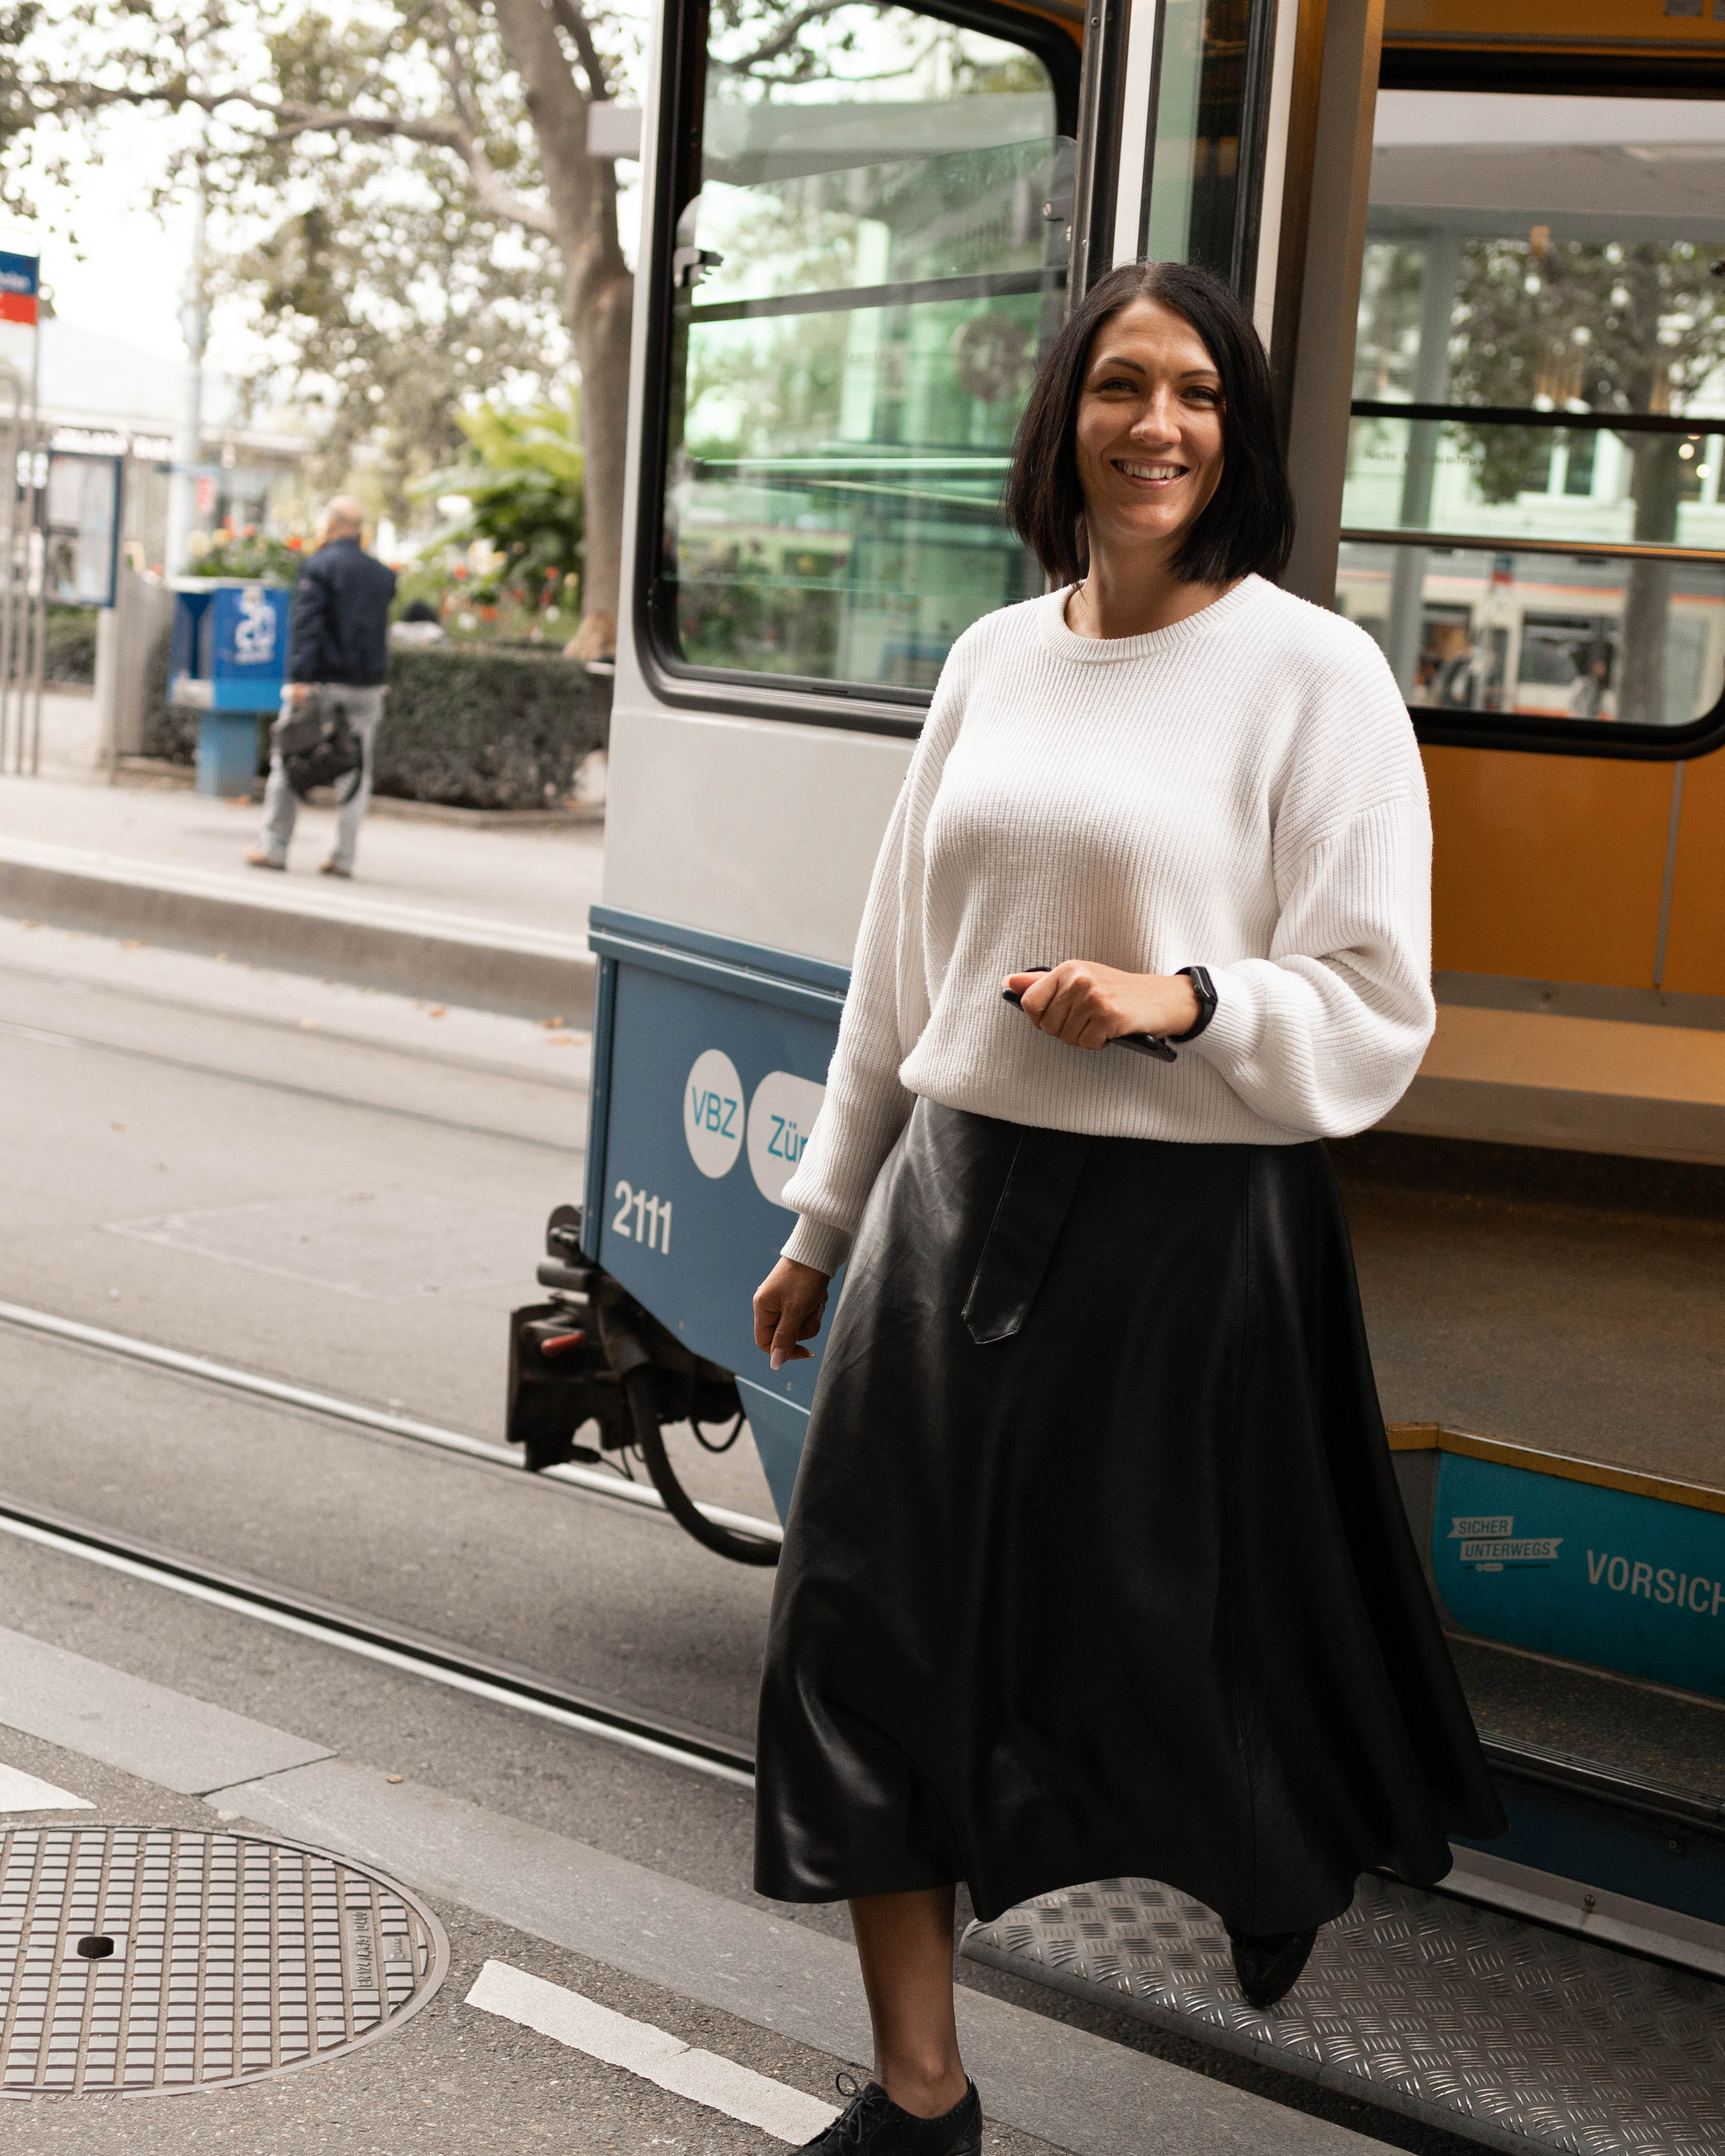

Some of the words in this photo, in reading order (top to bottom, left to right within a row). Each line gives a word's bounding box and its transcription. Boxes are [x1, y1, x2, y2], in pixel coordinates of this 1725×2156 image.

[692, 1086, 738, 1140] VBZ
[612, 1180, 672, 1255] 2111
[1459, 1519, 1508, 1535] SICHER
[1465, 1542, 1551, 1558] UNTERWEGS
